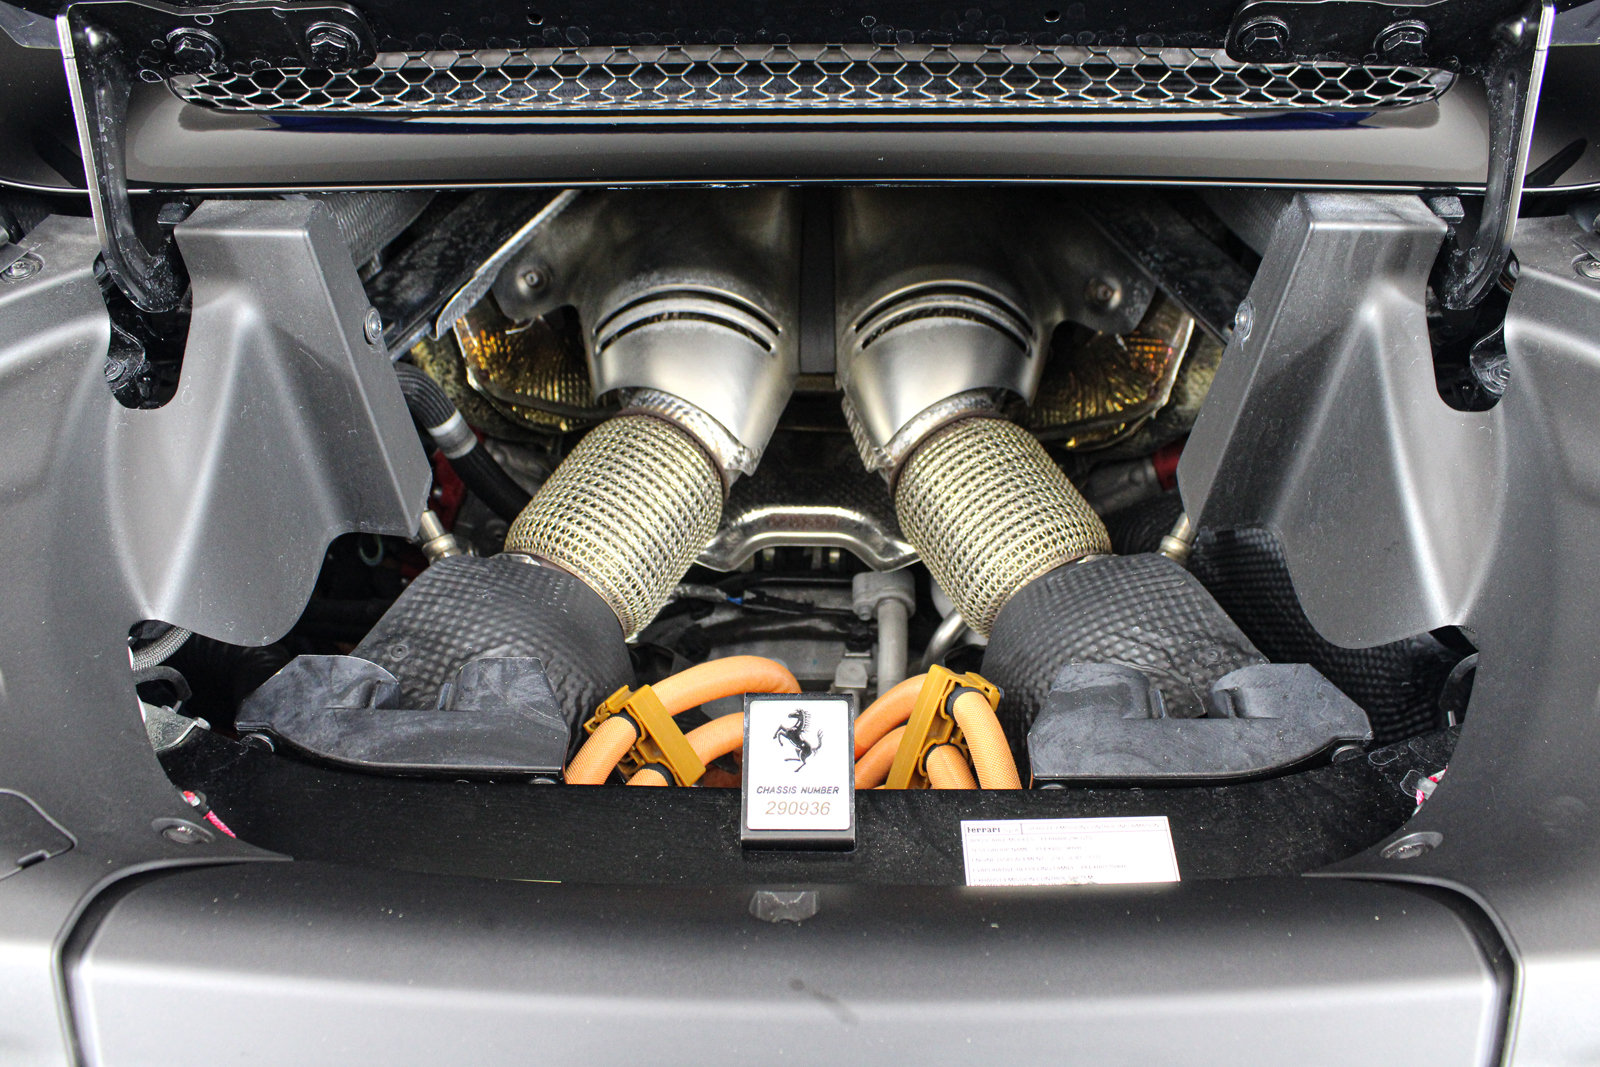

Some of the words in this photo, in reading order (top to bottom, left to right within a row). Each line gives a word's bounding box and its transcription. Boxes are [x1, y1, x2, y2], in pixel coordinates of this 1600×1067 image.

[756, 785, 797, 795] CHASSIS
[800, 785, 840, 795] NUMBER
[765, 800, 831, 815] 290936
